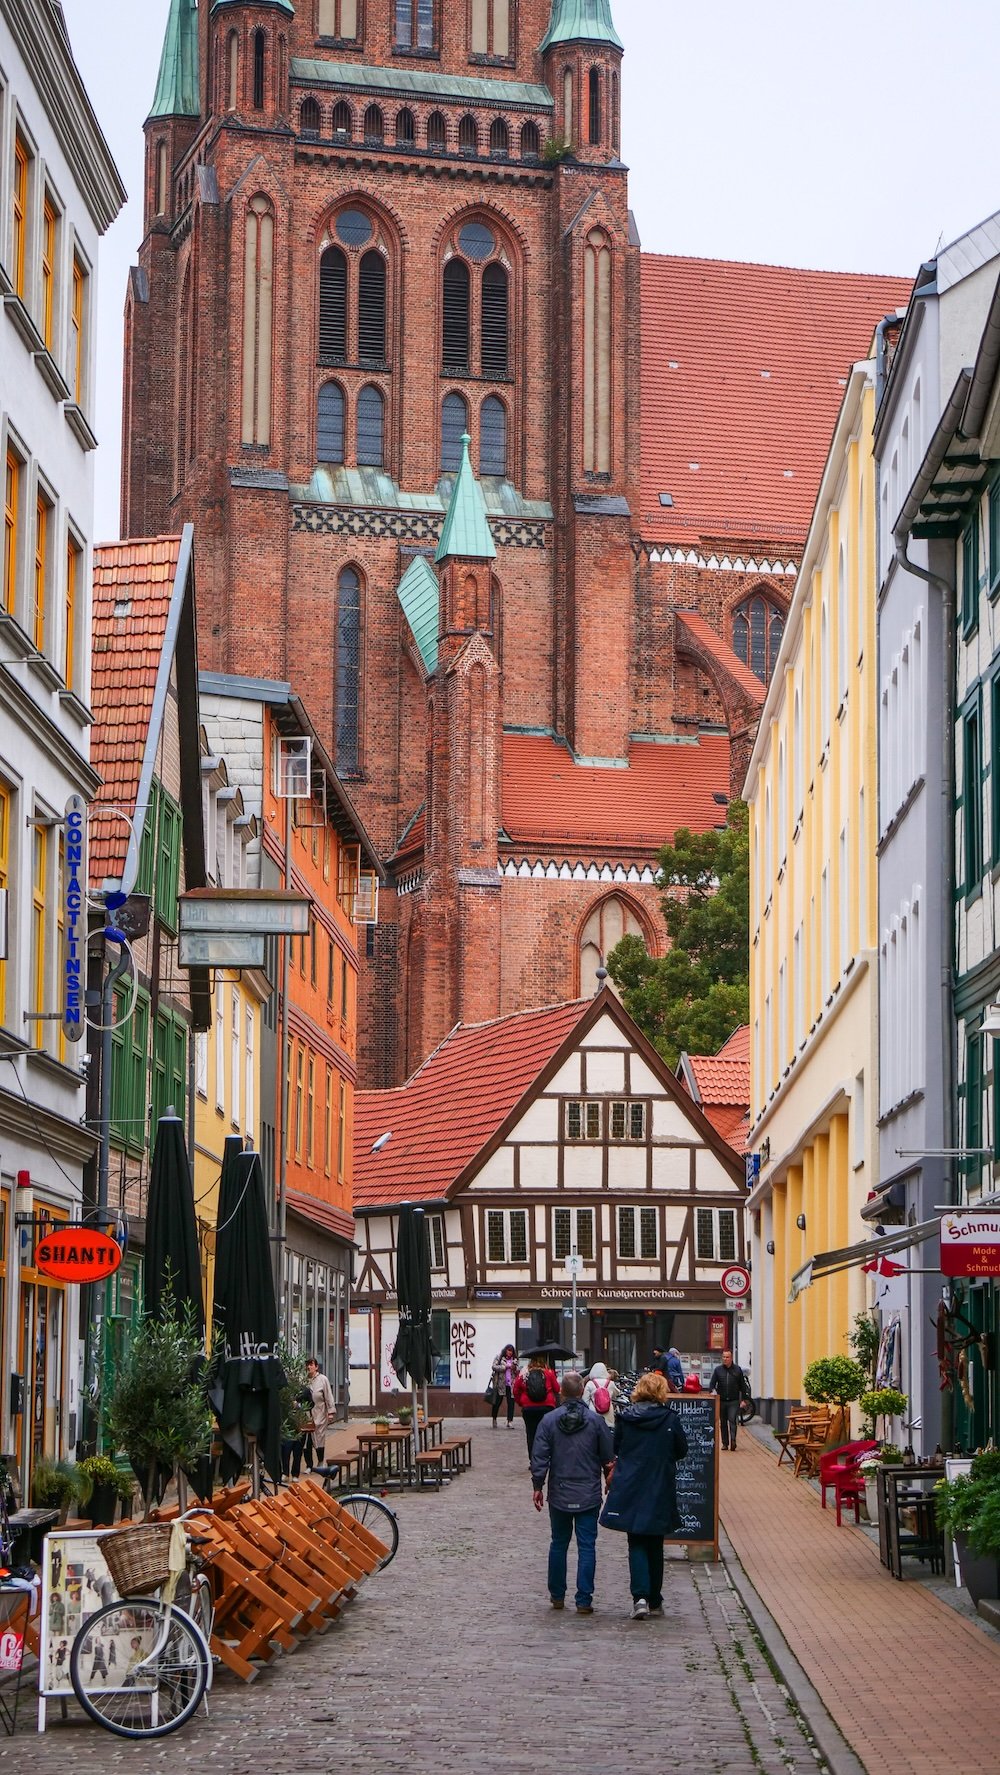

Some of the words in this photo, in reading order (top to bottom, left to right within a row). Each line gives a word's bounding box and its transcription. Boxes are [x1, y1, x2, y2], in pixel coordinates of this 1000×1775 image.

[65, 812, 82, 1024] CONTACTLINSEN
[948, 1222, 1000, 1240] Schmu
[39, 1245, 115, 1266] SHANTI
[972, 1246, 997, 1255] Mode
[981, 1255, 988, 1263] &
[540, 1287, 593, 1298] Schweiner
[597, 1288, 685, 1299] Kunstgewerbehaus
